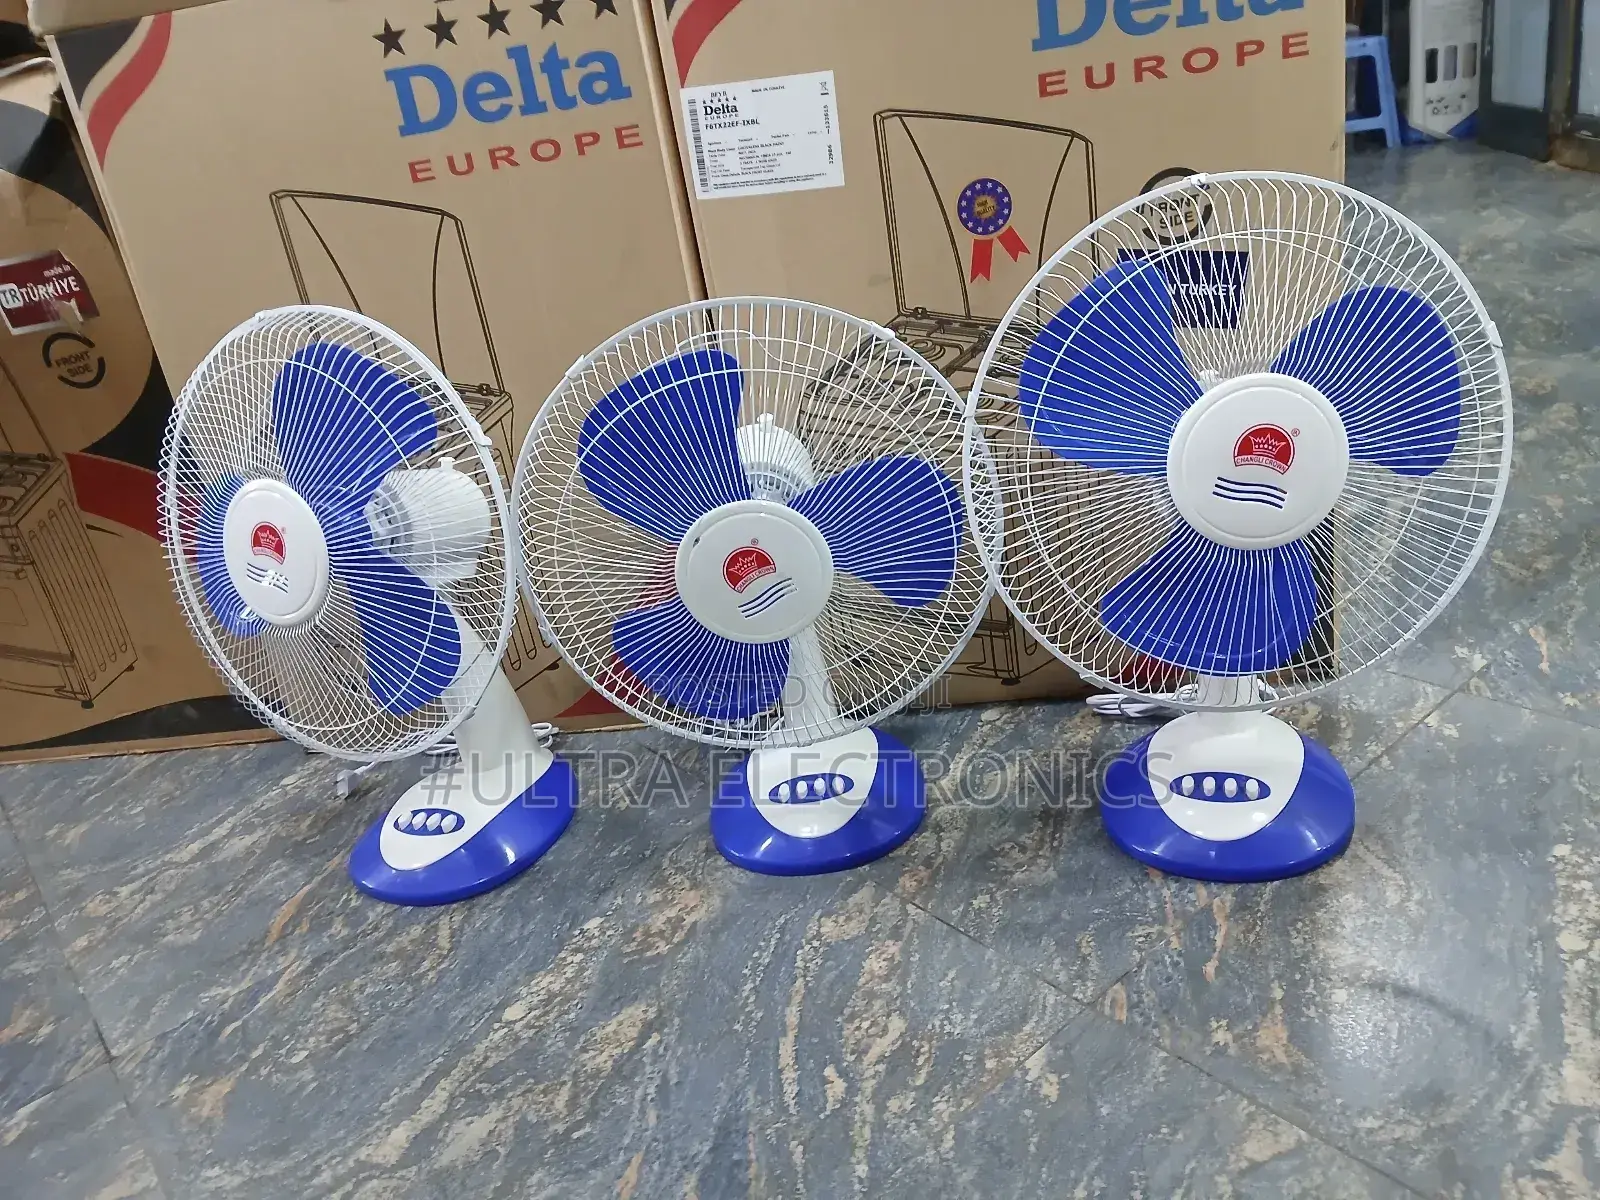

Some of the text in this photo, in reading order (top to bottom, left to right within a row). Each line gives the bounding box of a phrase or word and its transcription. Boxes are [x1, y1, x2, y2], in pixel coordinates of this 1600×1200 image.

[1037, 31, 1310, 98] EUROPE
[384, 41, 633, 138] Delta
[703, 104, 739, 116] Delta
[704, 113, 740, 121] EUROPE
[408, 124, 644, 184] EUROPE
[1159, 210, 1195, 229] SIDE
[43, 266, 63, 277] made
[1, 276, 80, 304] TR TÜRKİYE
[55, 350, 90, 367] FRONT
[66, 363, 93, 377] SIDE
[1264, 458, 1287, 472] CROWN
